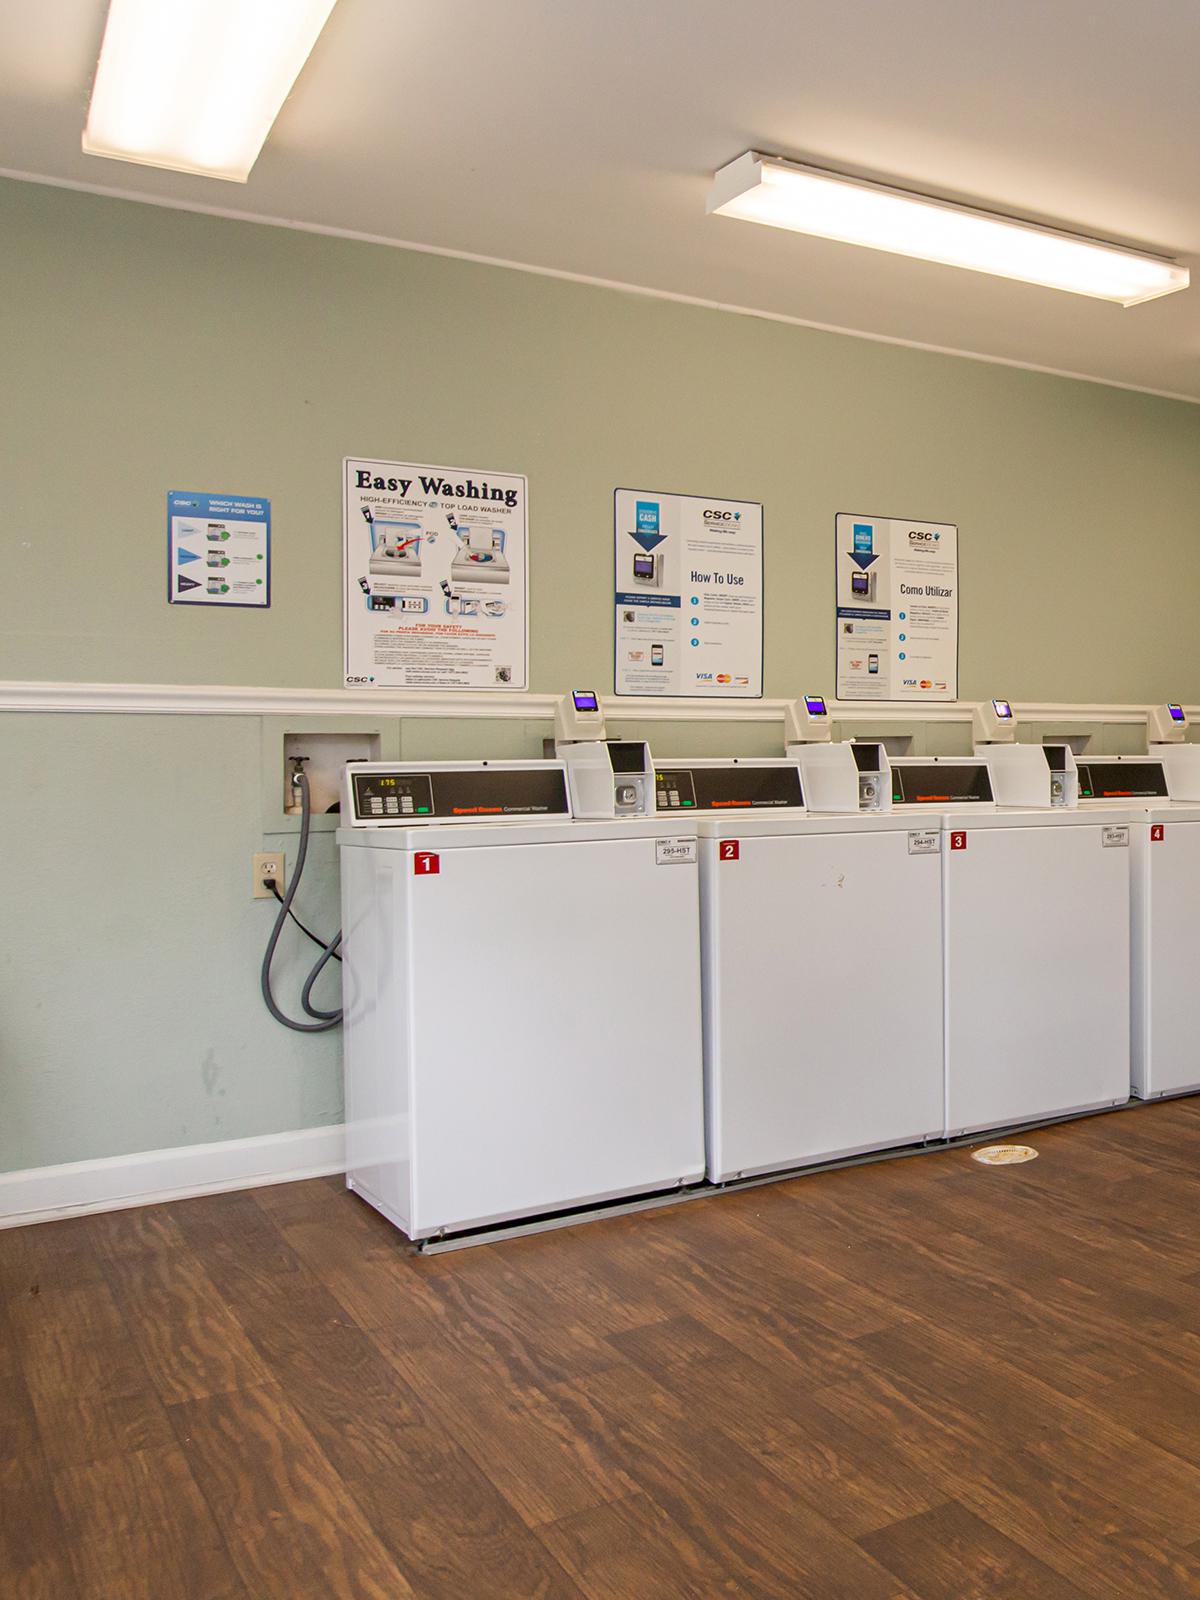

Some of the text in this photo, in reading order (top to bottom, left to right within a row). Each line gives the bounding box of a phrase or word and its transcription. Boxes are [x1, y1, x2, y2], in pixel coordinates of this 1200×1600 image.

[355, 470, 518, 507] Easy Washing
[360, 496, 428, 507] HIGH-EFFICIENCY
[457, 504, 479, 512] LOAD
[480, 506, 512, 514] WASHER
[703, 509, 732, 520] CSC
[908, 531, 933, 541] CSC
[691, 571, 744, 585] How To Use
[900, 583, 953, 597] Como Utilizar
[1154, 829, 1160, 839] 4
[955, 836, 962, 847] 3
[725, 845, 734, 858] 2
[422, 857, 430, 871] 1
